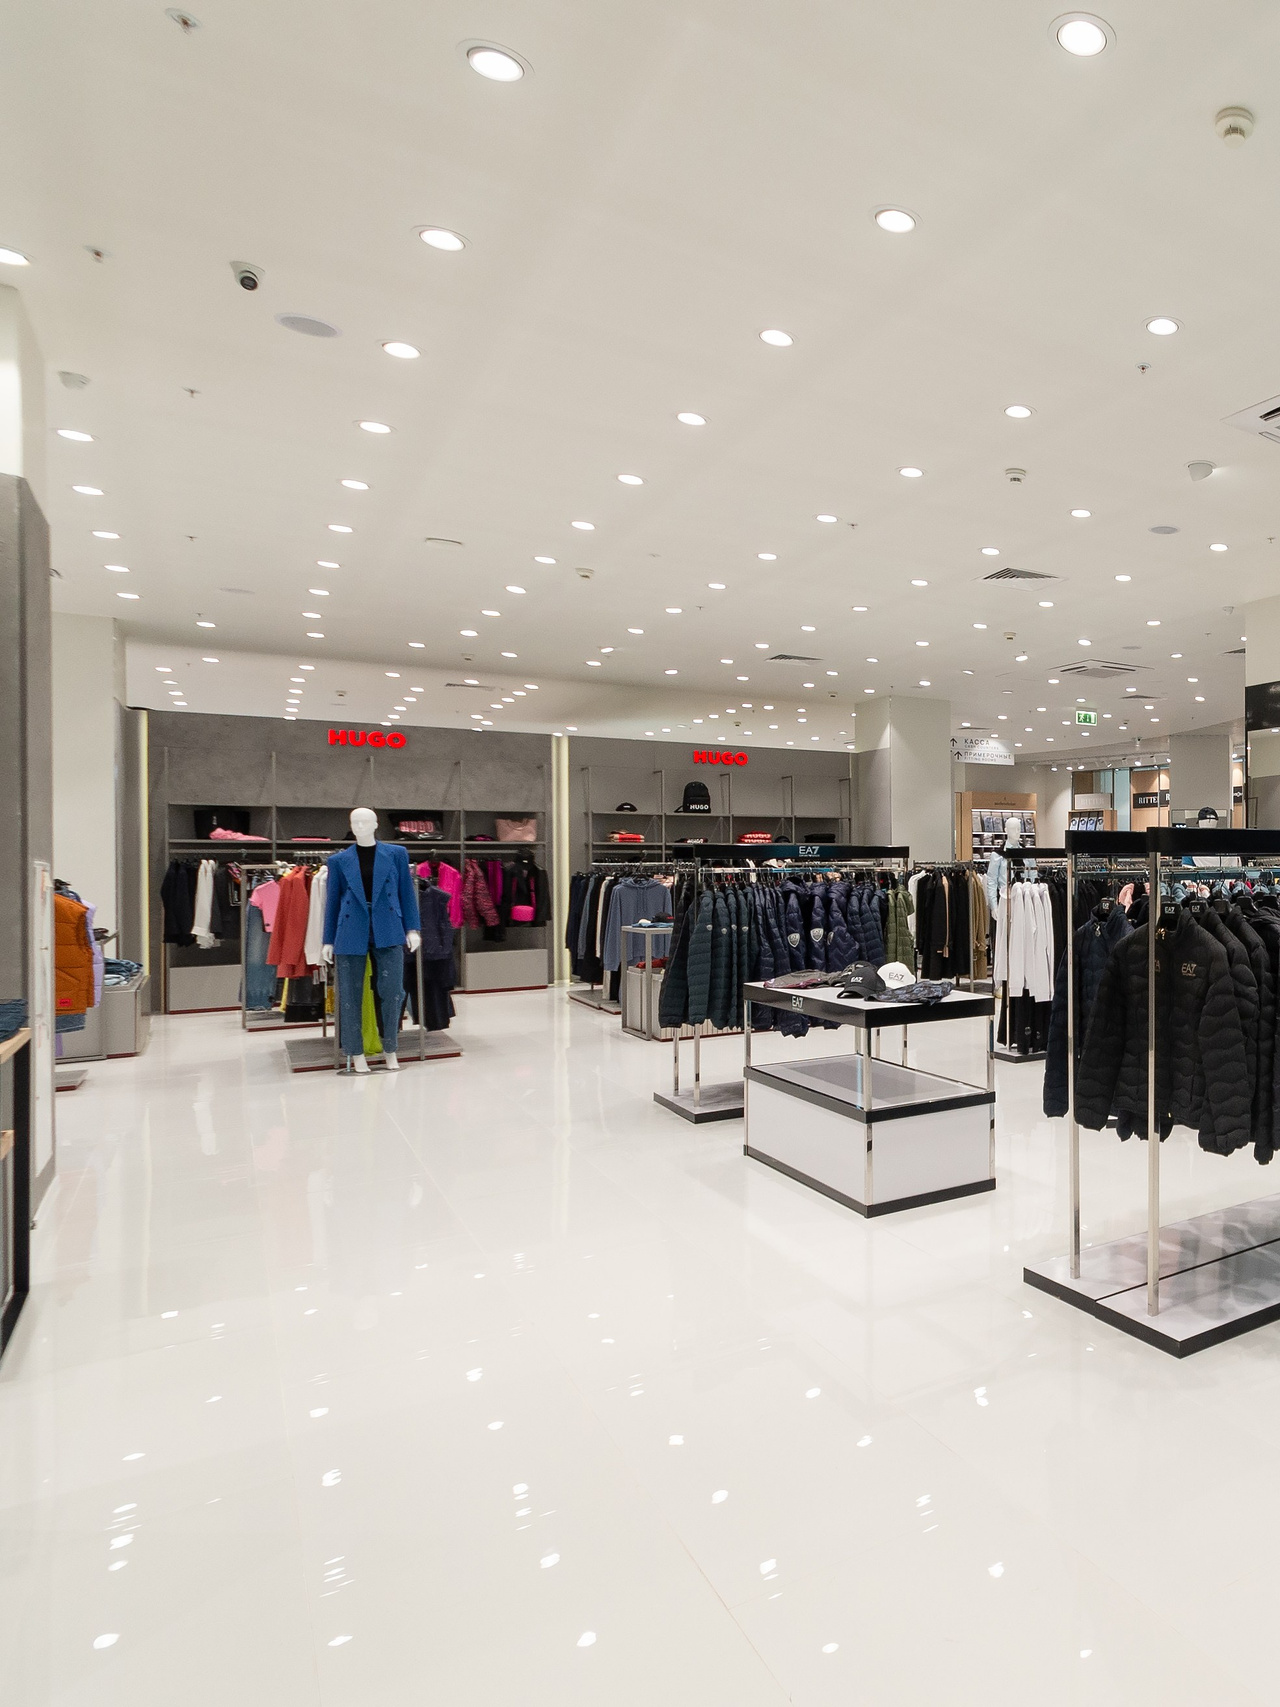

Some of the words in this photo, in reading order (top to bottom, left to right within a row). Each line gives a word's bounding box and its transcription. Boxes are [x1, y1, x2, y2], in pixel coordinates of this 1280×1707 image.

[327, 728, 407, 749] HUGO
[964, 738, 990, 746] КАССА
[692, 750, 749, 766] HUGO
[964, 751, 1012, 760] ПРИМЕРОЧНЫЕ
[1138, 796, 1158, 805] RITTE
[798, 846, 820, 855] EA7
[1181, 962, 1197, 974] EA7
[888, 972, 905, 983] EA7
[791, 995, 804, 1009] EA7
